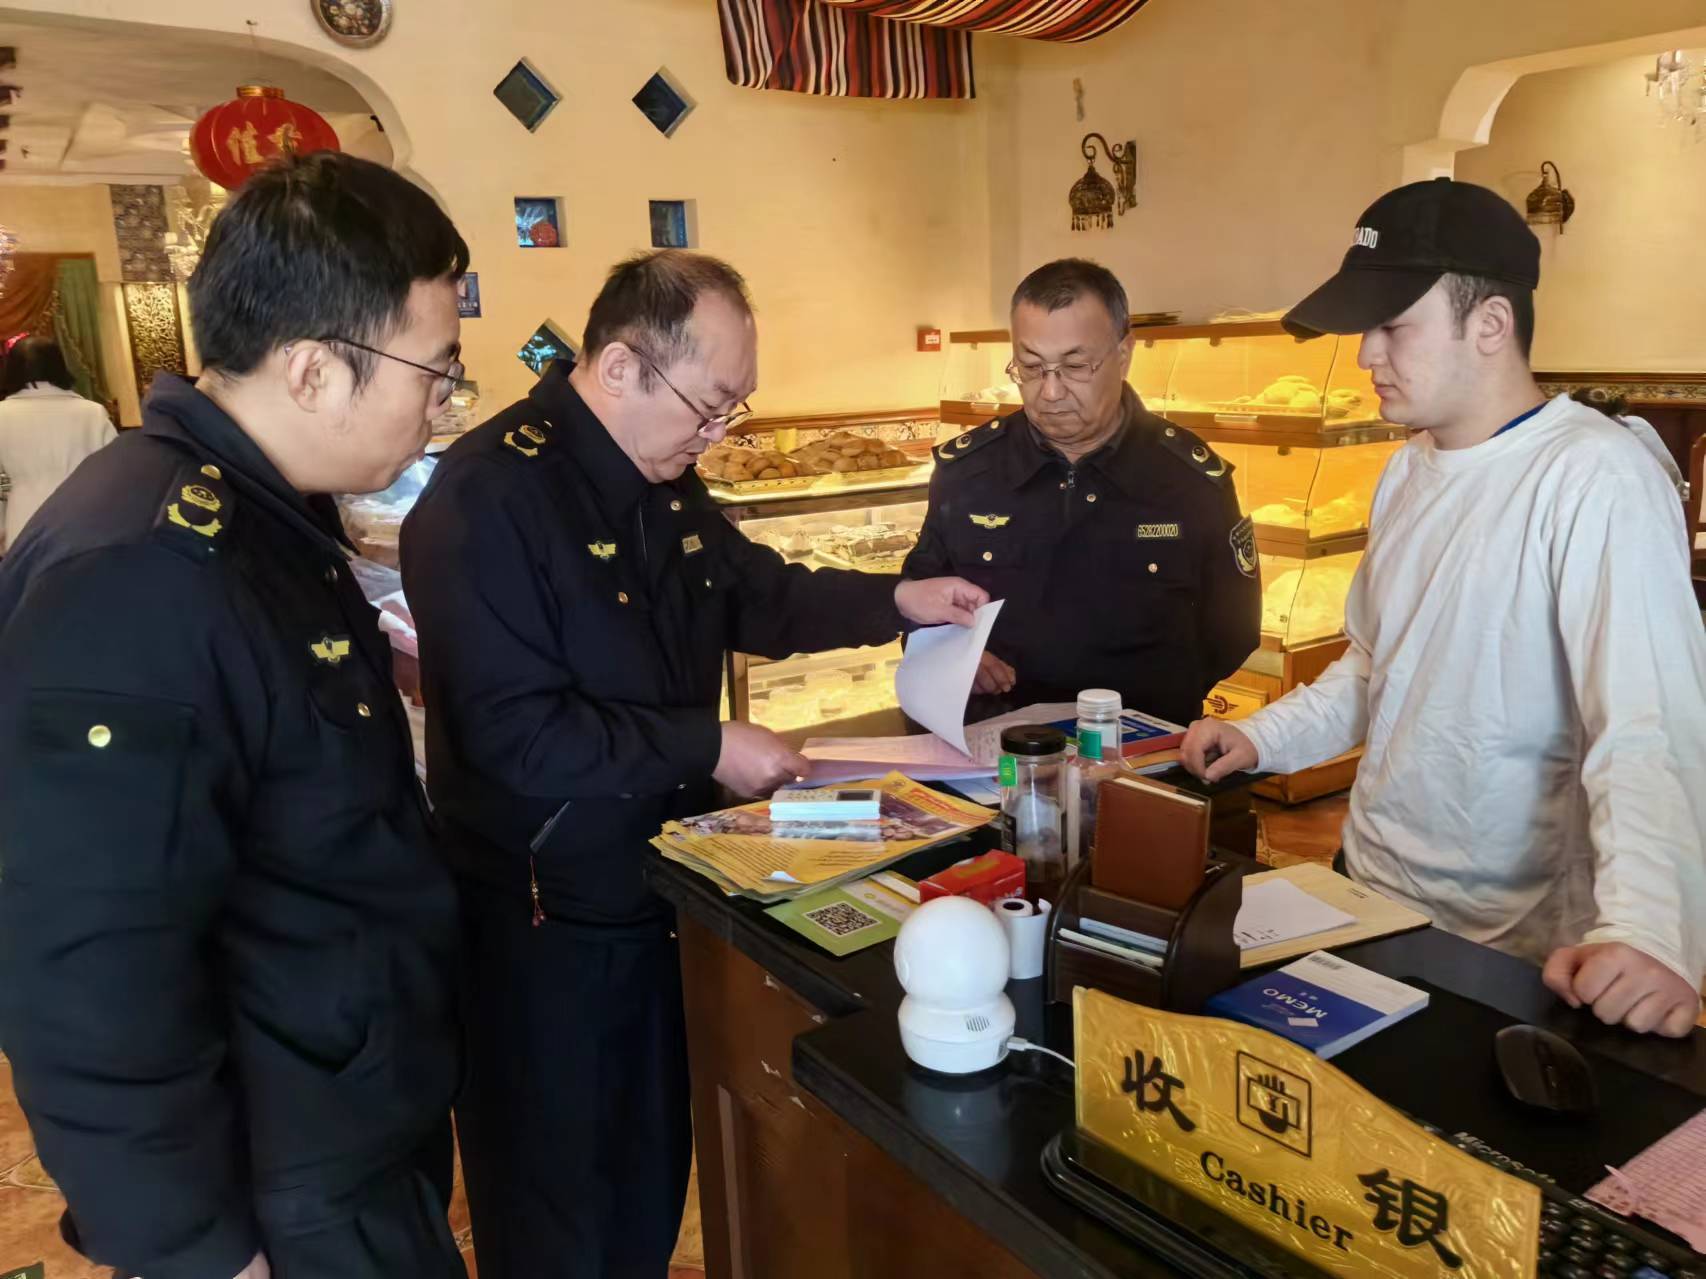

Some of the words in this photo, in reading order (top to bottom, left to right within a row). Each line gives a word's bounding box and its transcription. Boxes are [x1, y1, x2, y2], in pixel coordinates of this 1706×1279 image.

[1263, 988, 1329, 1018] MEMO
[1121, 1048, 1196, 1132] 收
[1356, 1167, 1464, 1270] 银
[1200, 1150, 1354, 1252] Cashier
